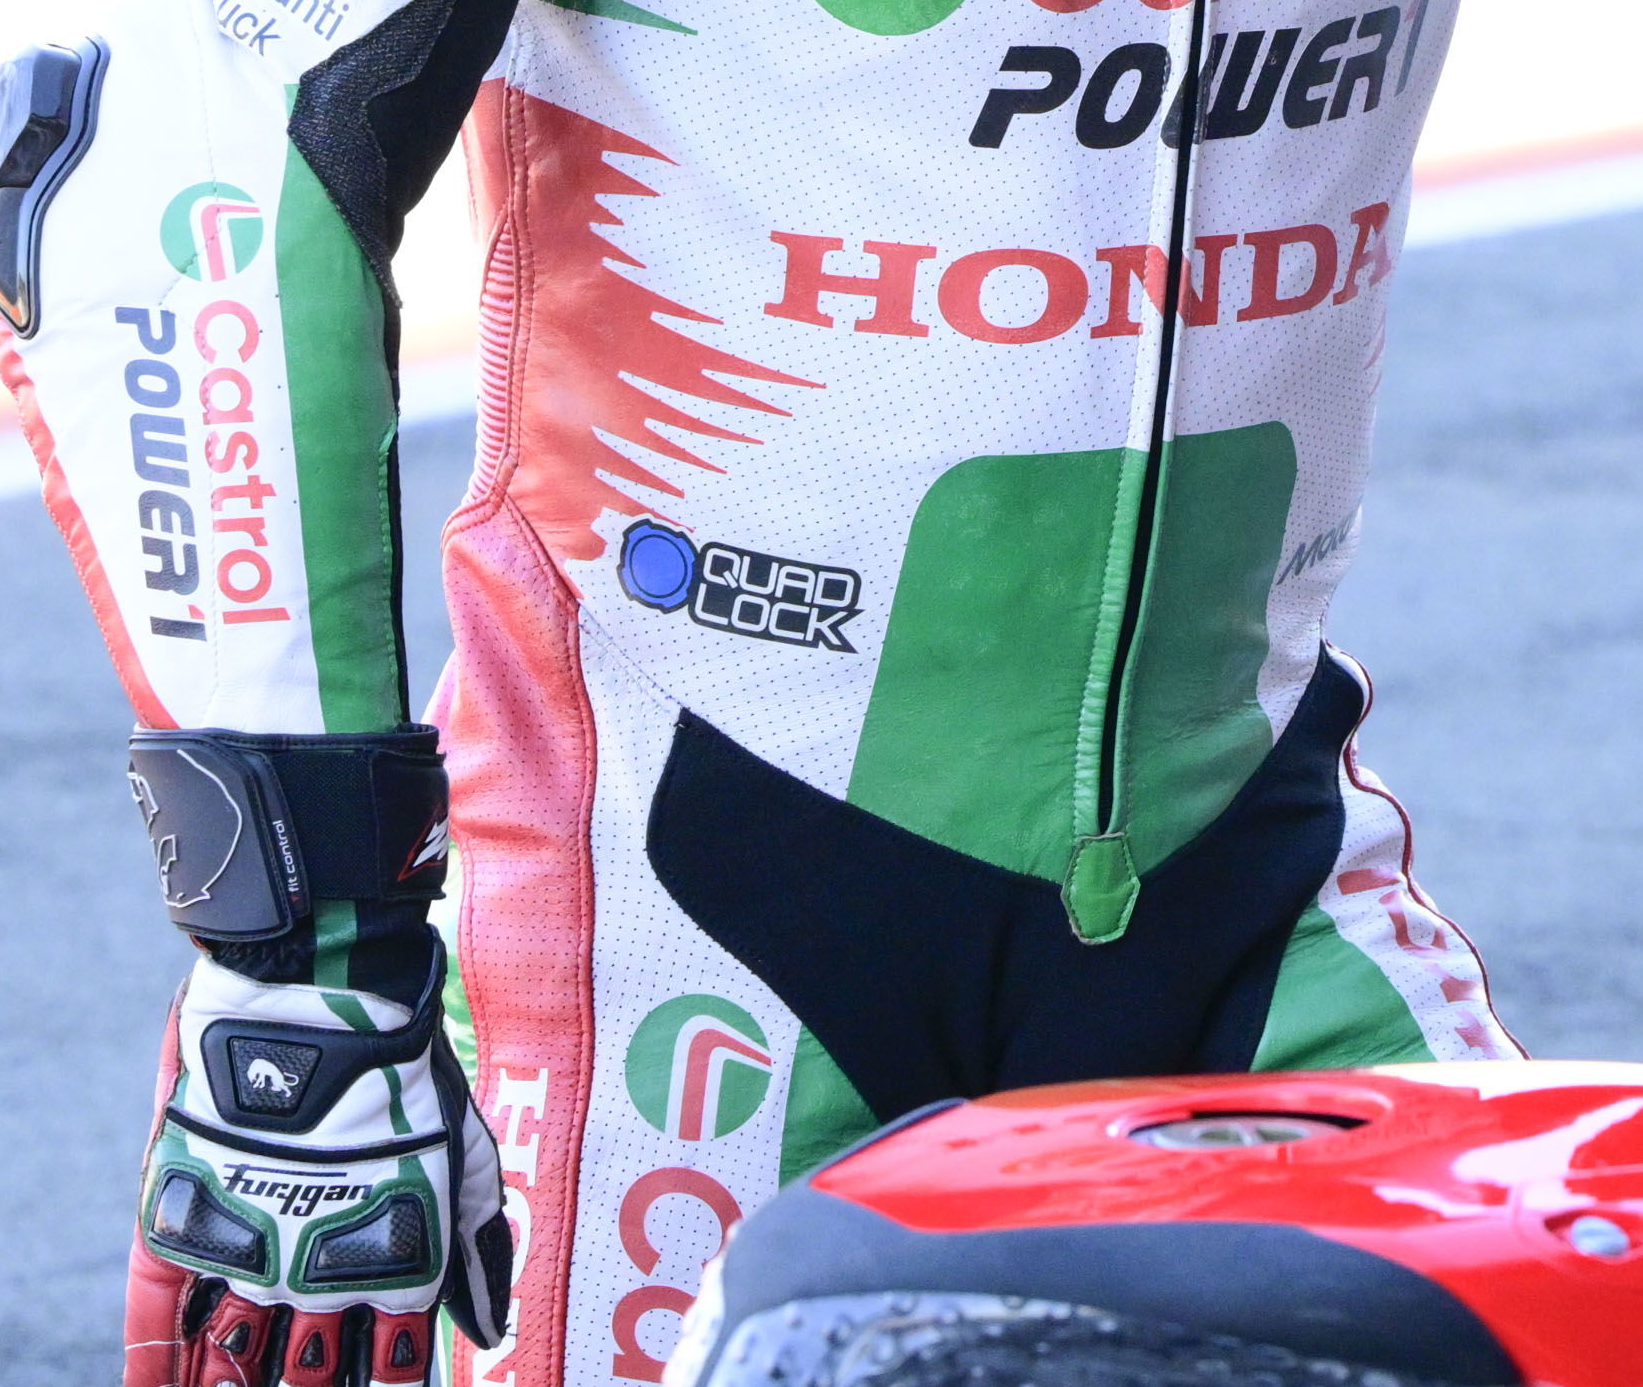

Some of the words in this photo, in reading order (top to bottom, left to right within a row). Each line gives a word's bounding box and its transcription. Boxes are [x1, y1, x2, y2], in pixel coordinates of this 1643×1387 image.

[764, 201, 1393, 345] HONDA
[114, 305, 207, 642] POWER1
[194, 298, 291, 625] Castrol
[700, 548, 856, 609] QUAD
[690, 591, 849, 647] LOCK
[273, 819, 295, 873] control
[288, 877, 300, 893] fit
